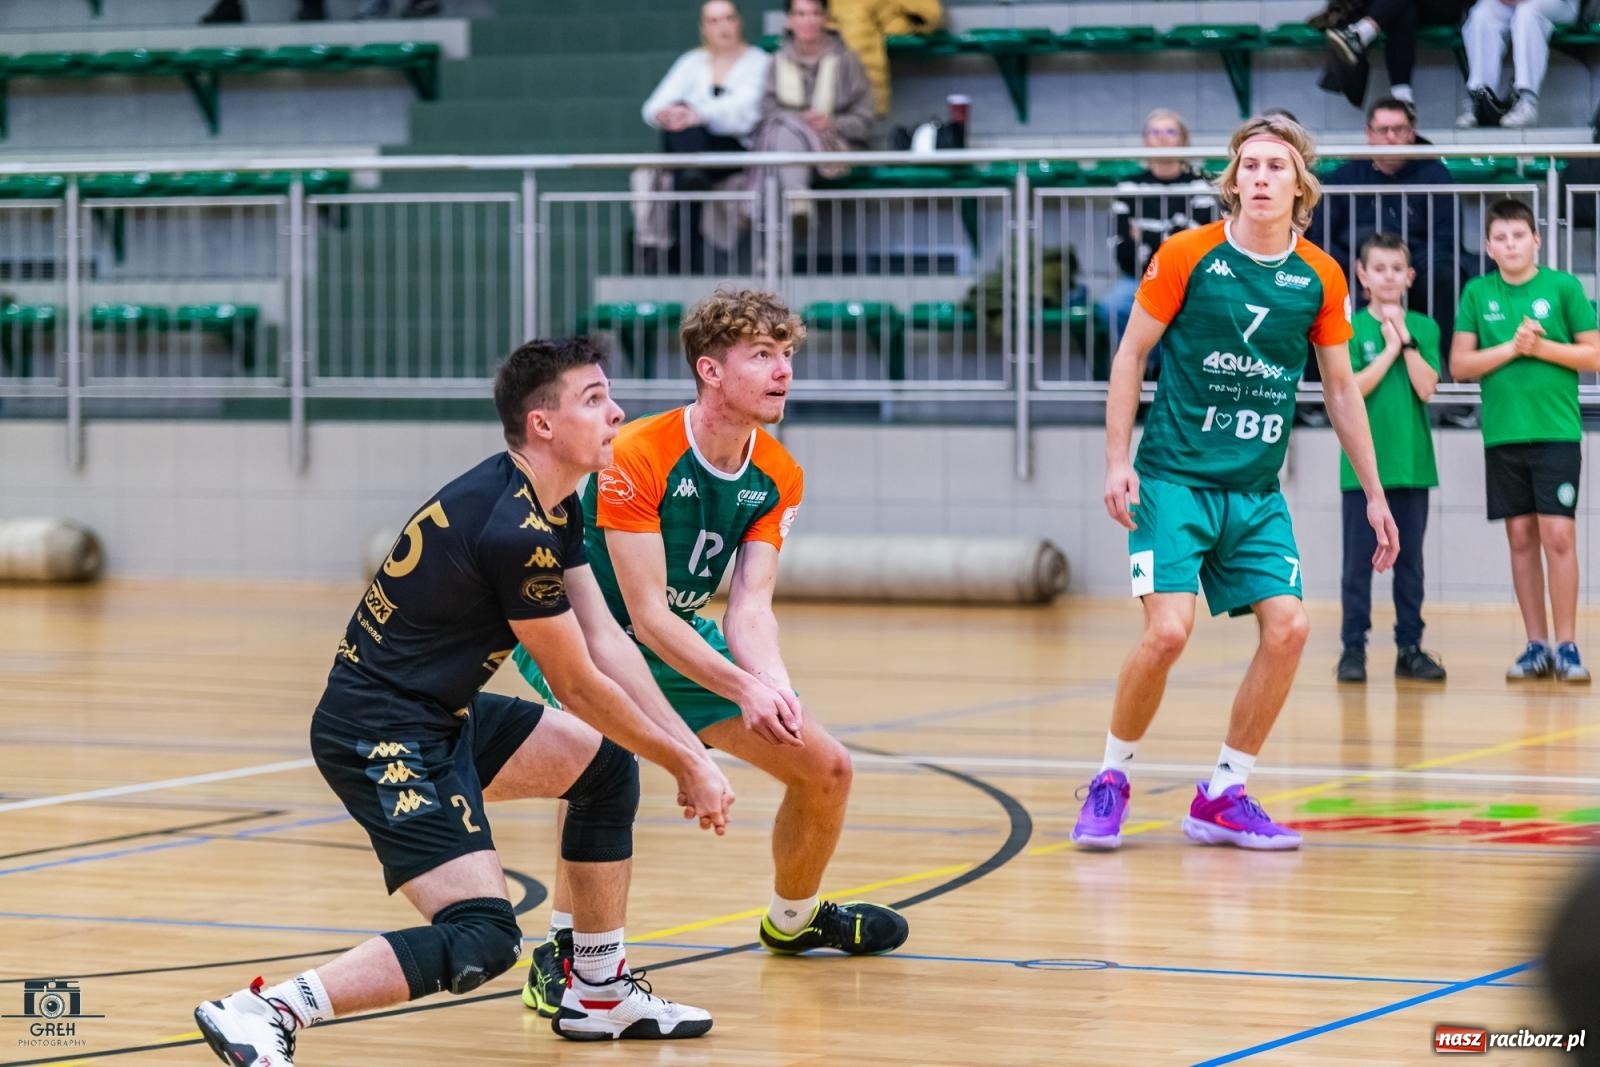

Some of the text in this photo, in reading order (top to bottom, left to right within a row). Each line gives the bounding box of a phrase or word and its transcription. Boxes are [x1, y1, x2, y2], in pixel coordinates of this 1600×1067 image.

[1244, 303, 1271, 343] 7
[1245, 386, 1249, 395] i
[1284, 555, 1300, 588] 7
[450, 794, 481, 833] 2
